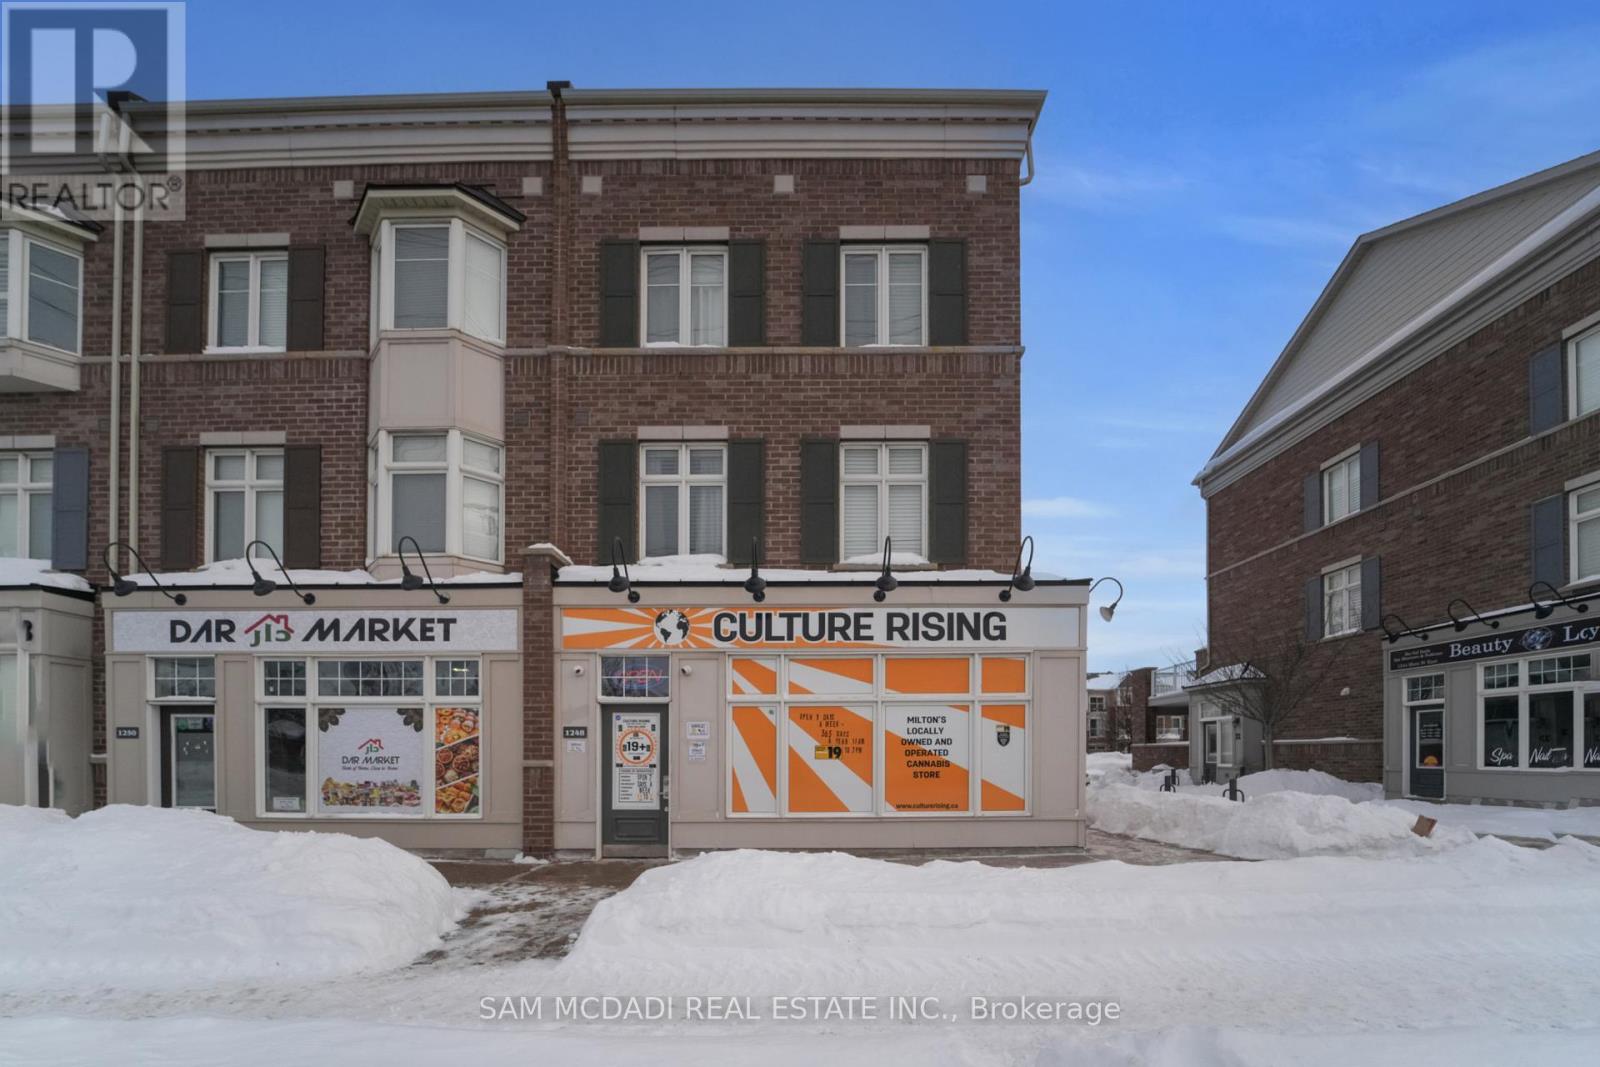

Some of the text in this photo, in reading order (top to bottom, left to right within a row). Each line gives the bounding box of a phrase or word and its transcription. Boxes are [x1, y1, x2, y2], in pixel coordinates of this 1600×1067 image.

[170, 619, 236, 643] DAR
[302, 617, 457, 642] MARKET
[713, 611, 1007, 641] CULTURE RISING
[1449, 638, 1513, 658] Beauty
[907, 716, 947, 724] MILTON'S
[907, 727, 944, 735] LOCALLY
[626, 741, 646, 752] 19+
[901, 738, 953, 746] OWNED AND
[828, 746, 842, 759] 19
[904, 749, 949, 757] OPERATED
[1490, 747, 1513, 765] Spa
[342, 755, 400, 764] DAR MARKET
[906, 760, 950, 768] CANNABIS
[912, 771, 941, 779] STORE
